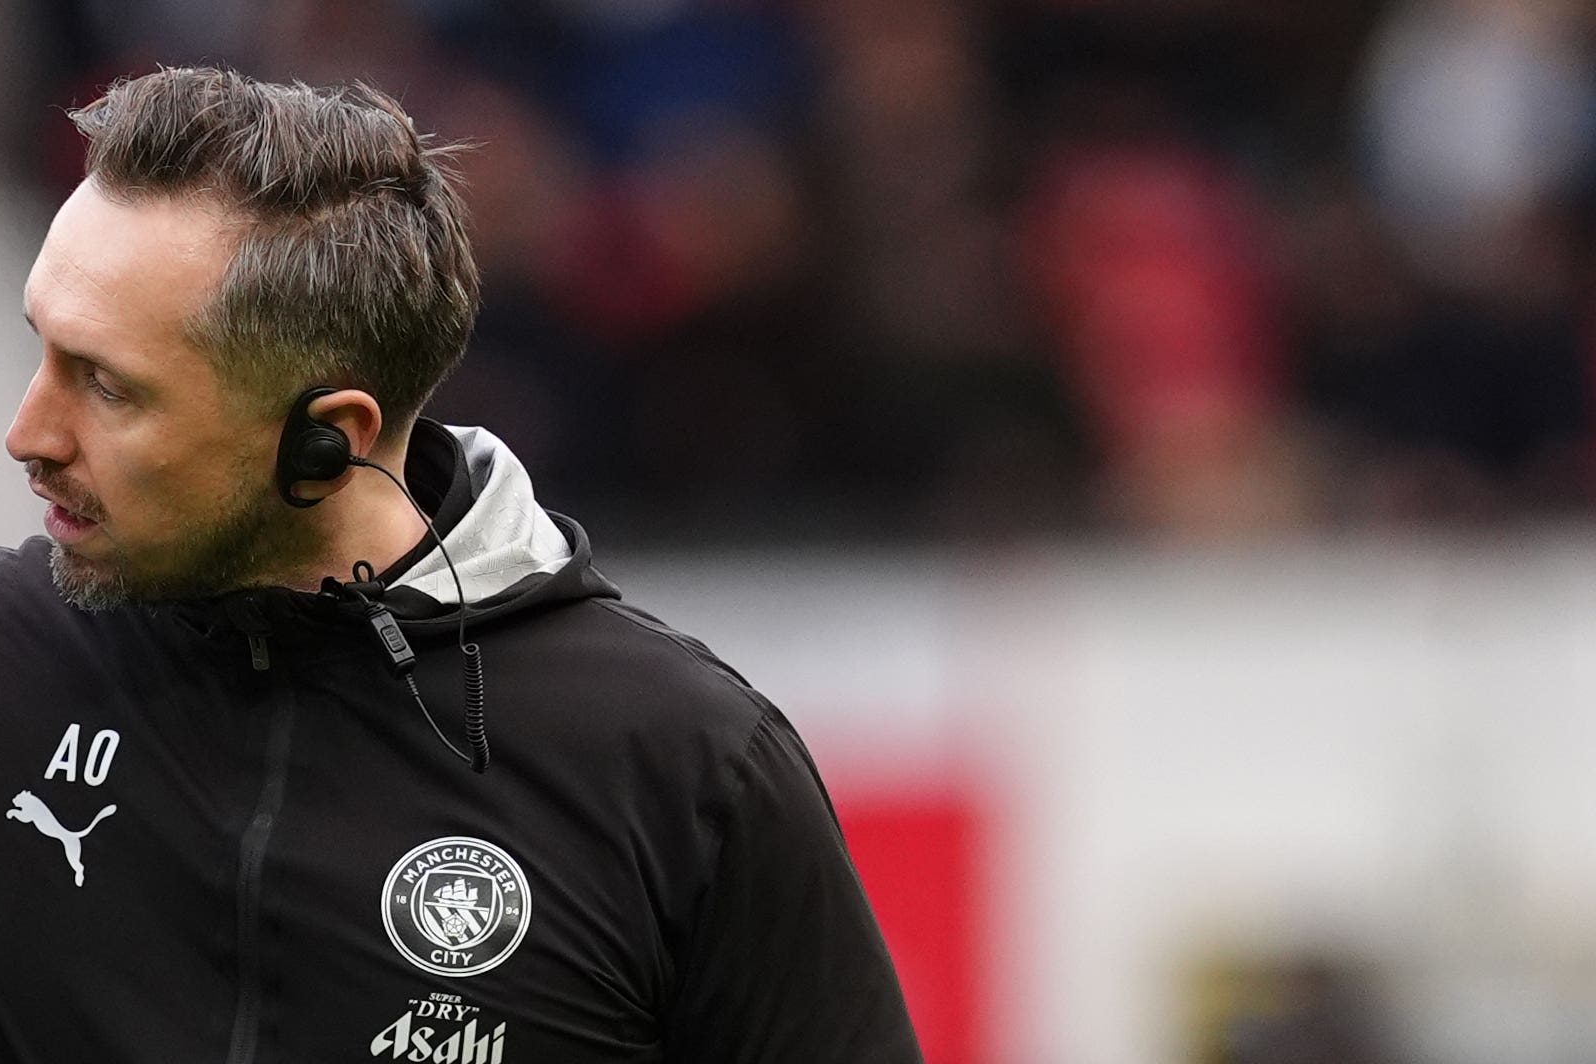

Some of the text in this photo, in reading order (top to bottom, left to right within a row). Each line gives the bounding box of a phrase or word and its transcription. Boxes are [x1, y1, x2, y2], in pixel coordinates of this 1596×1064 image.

[44, 723, 120, 786] AO
[402, 847, 516, 893] MANCHESTER
[505, 906, 519, 916] 94
[430, 949, 473, 966] CITY
[428, 992, 462, 1003] SUPER
